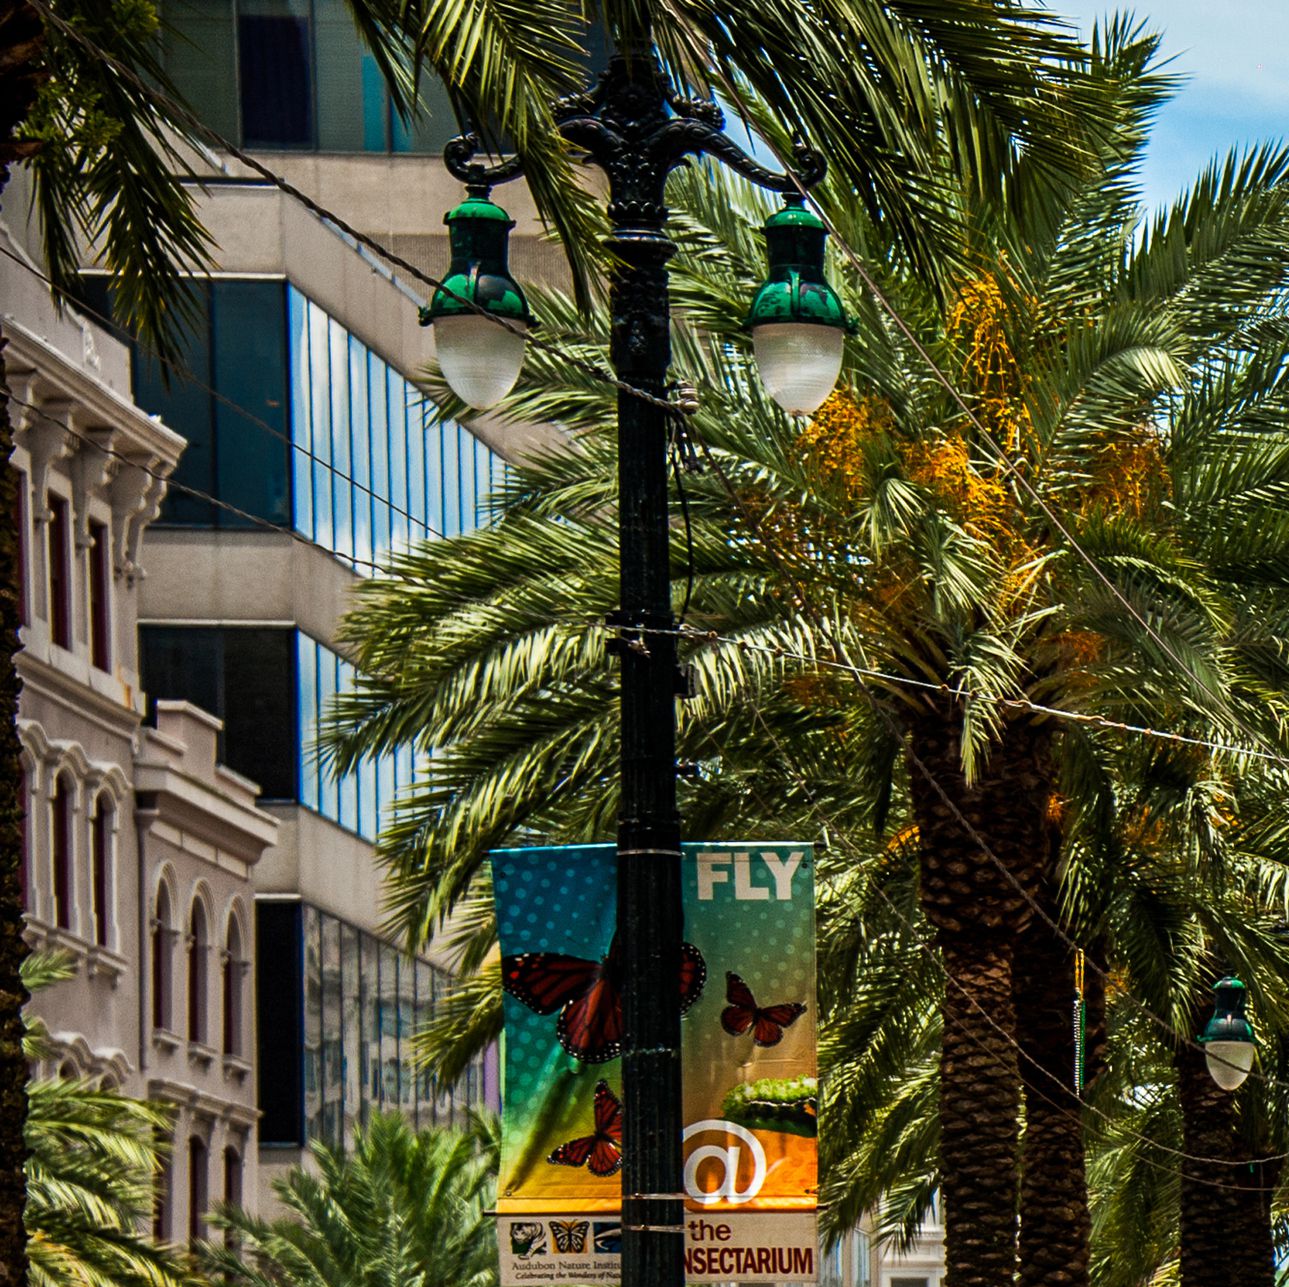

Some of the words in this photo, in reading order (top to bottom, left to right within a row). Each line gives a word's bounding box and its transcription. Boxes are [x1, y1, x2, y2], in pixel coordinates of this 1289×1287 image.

[697, 852, 804, 900] FLY
[688, 1219, 732, 1241] the
[512, 1261, 555, 1271] Audubon
[559, 1261, 591, 1270] Nature
[684, 1247, 813, 1275] NSECTARIUM
